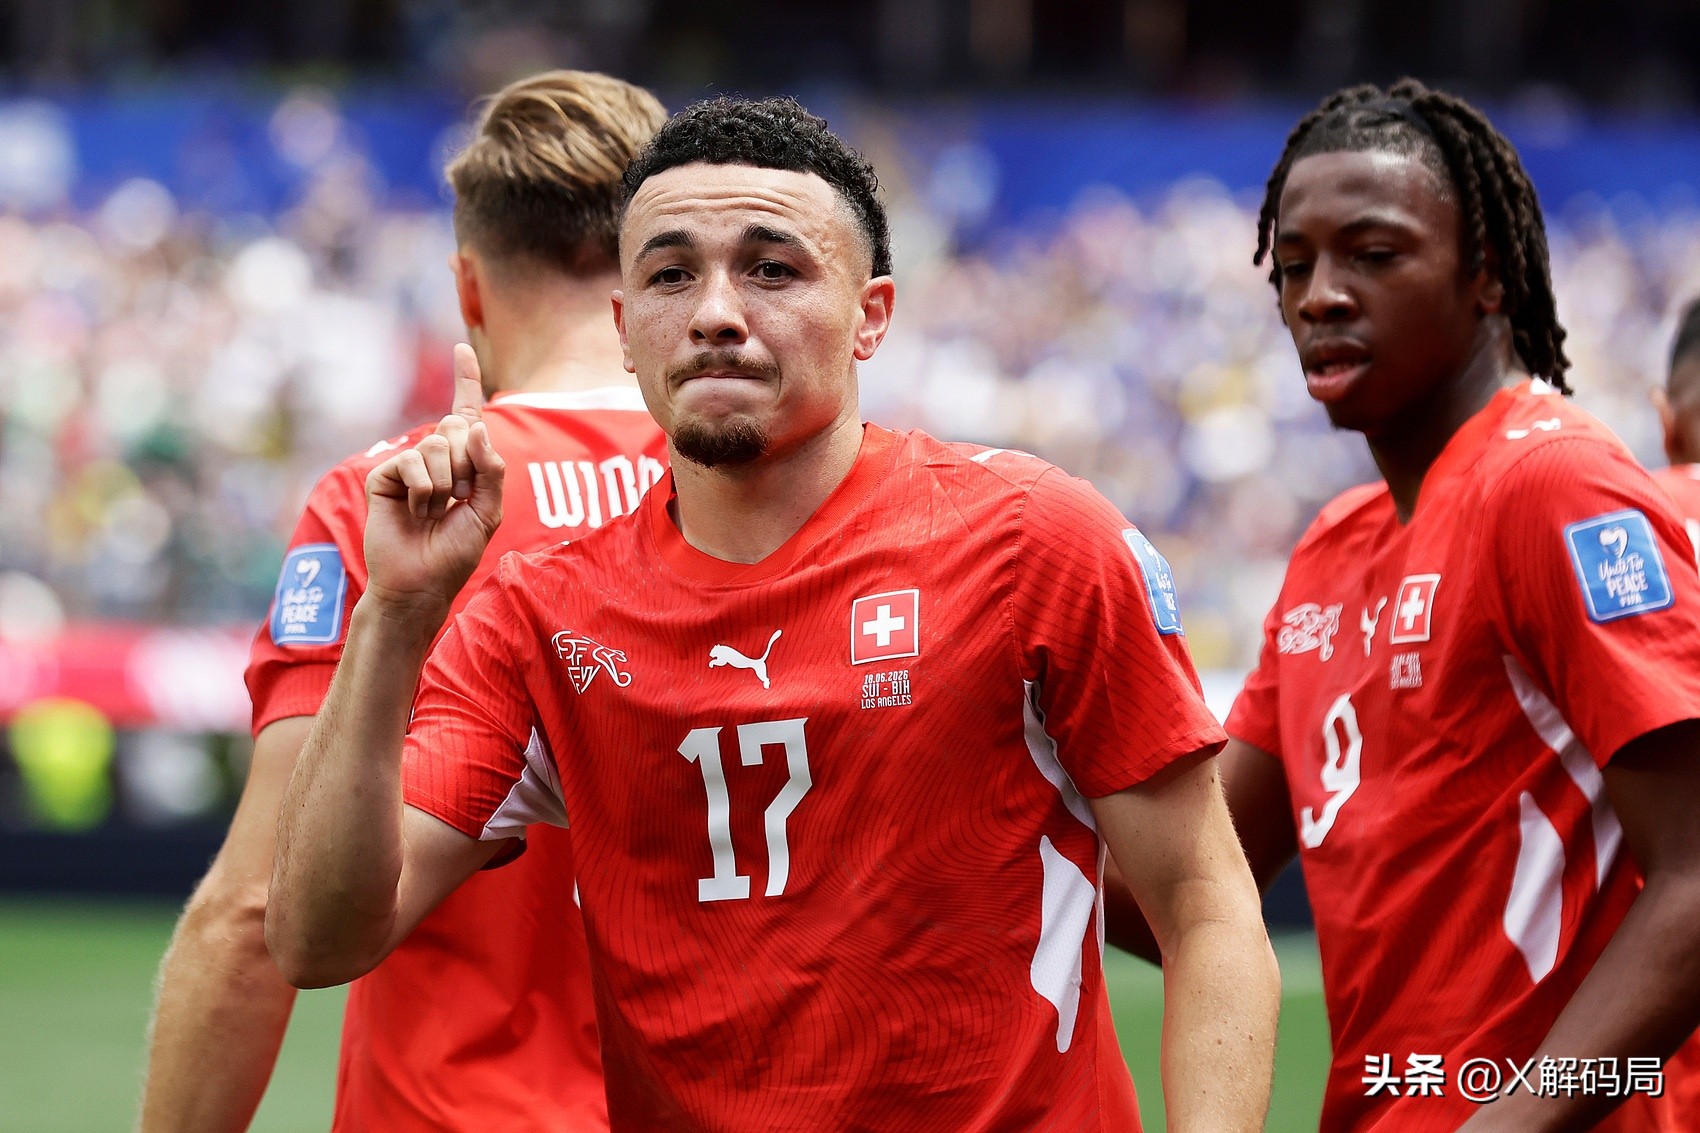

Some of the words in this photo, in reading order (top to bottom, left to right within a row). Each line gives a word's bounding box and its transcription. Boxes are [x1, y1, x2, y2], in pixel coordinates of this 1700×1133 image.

[1606, 570, 1649, 599] PEACE
[861, 682, 880, 699] SUI
[891, 679, 911, 695] BIH
[864, 669, 909, 685] 18.06.2026
[861, 698, 876, 710] LOS
[877, 694, 912, 708] ANGELES
[1301, 692, 1363, 849] 9
[677, 717, 813, 902] 17
